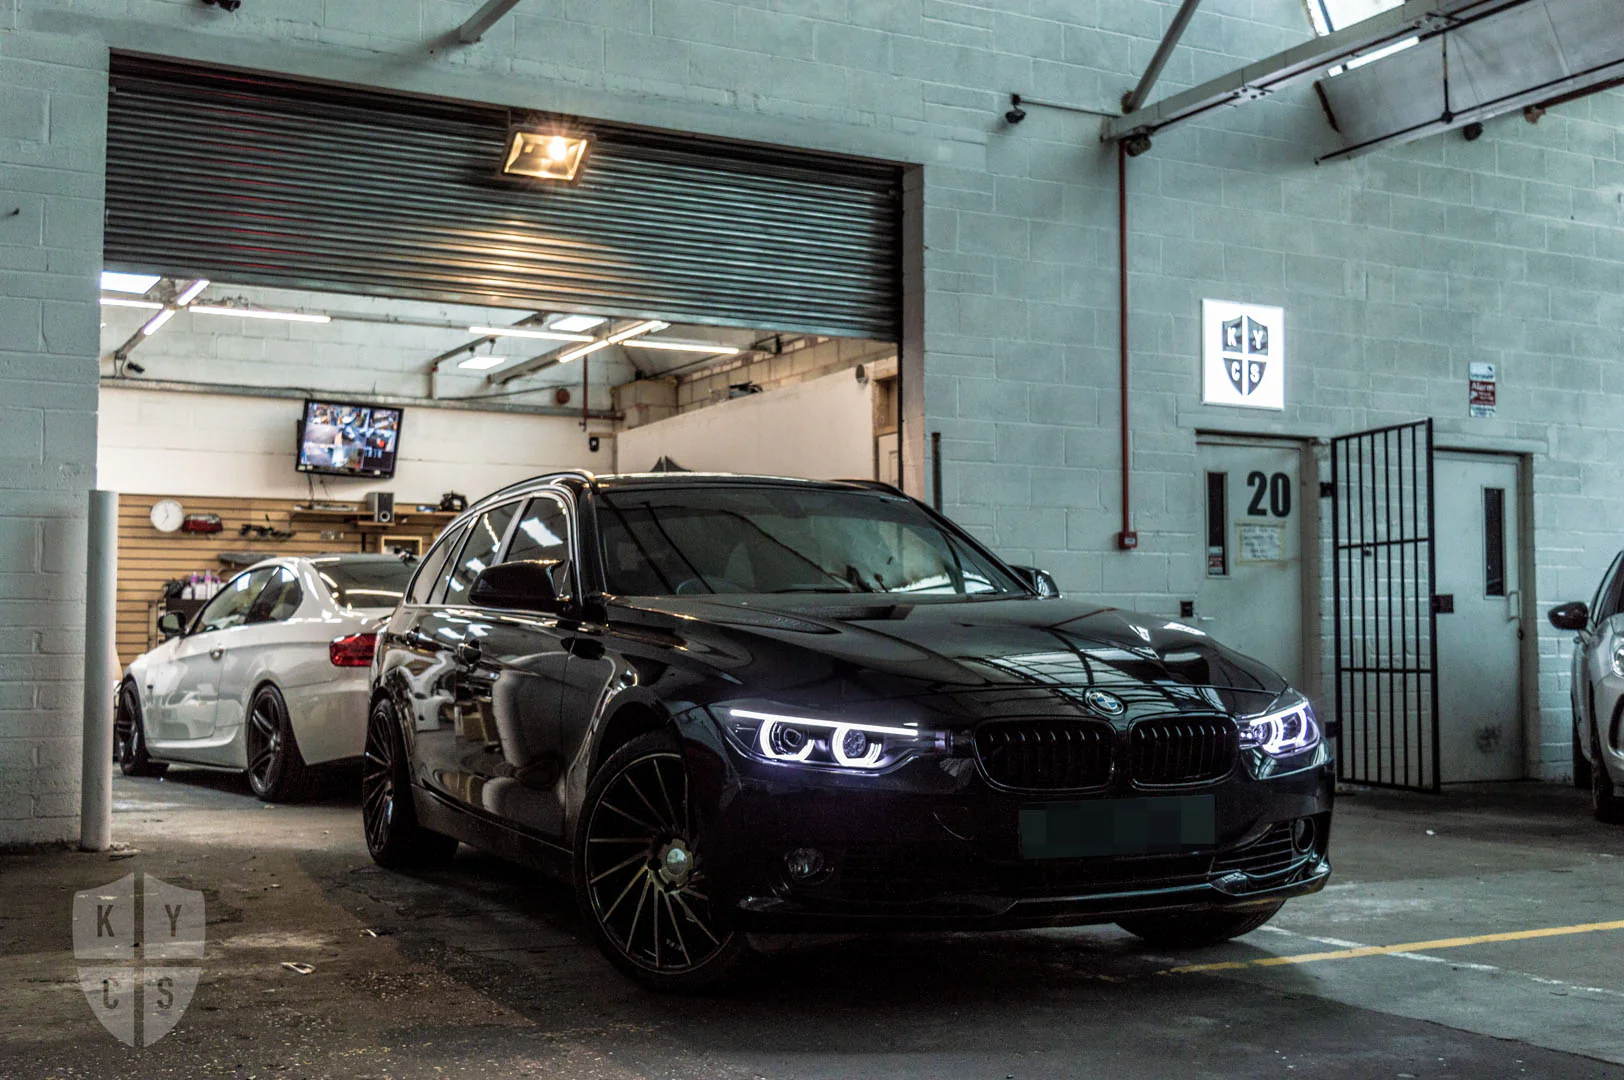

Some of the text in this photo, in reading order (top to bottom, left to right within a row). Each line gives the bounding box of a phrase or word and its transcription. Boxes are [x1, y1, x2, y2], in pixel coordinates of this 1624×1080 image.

[1227, 327, 1263, 350] K Y
[1231, 361, 1260, 383] C S
[1247, 470, 1291, 517] 20
